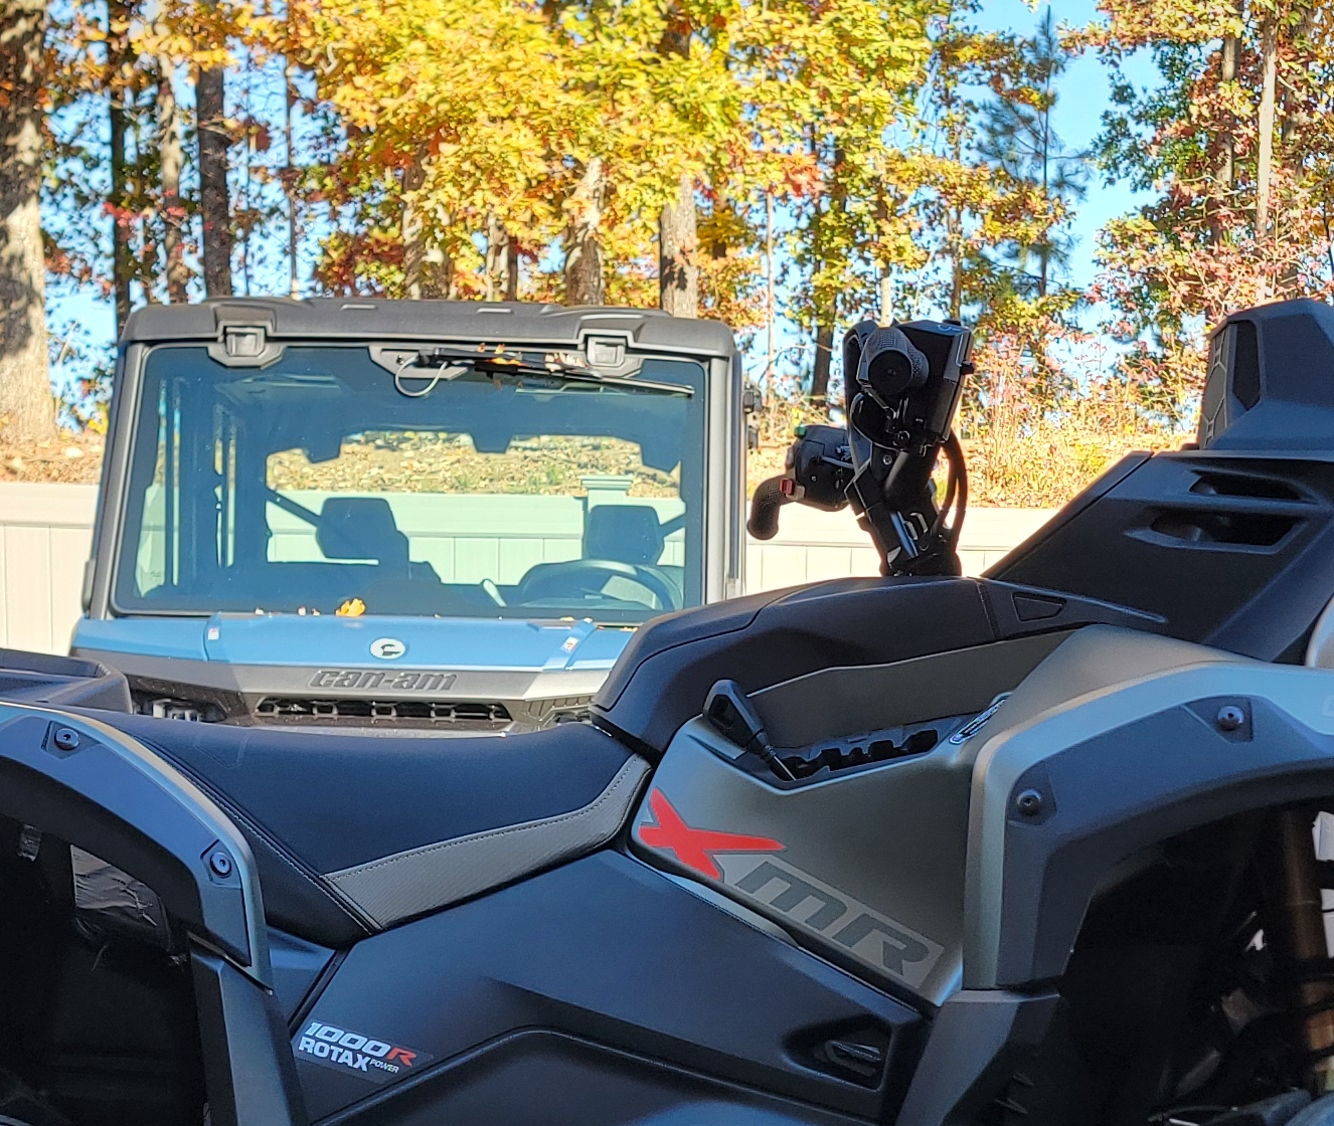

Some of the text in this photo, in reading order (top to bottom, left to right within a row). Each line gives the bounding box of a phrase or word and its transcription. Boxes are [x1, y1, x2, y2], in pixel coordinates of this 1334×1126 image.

[299, 1036, 399, 1074] ROTAX POWER
[305, 1022, 416, 1067] 1000R
